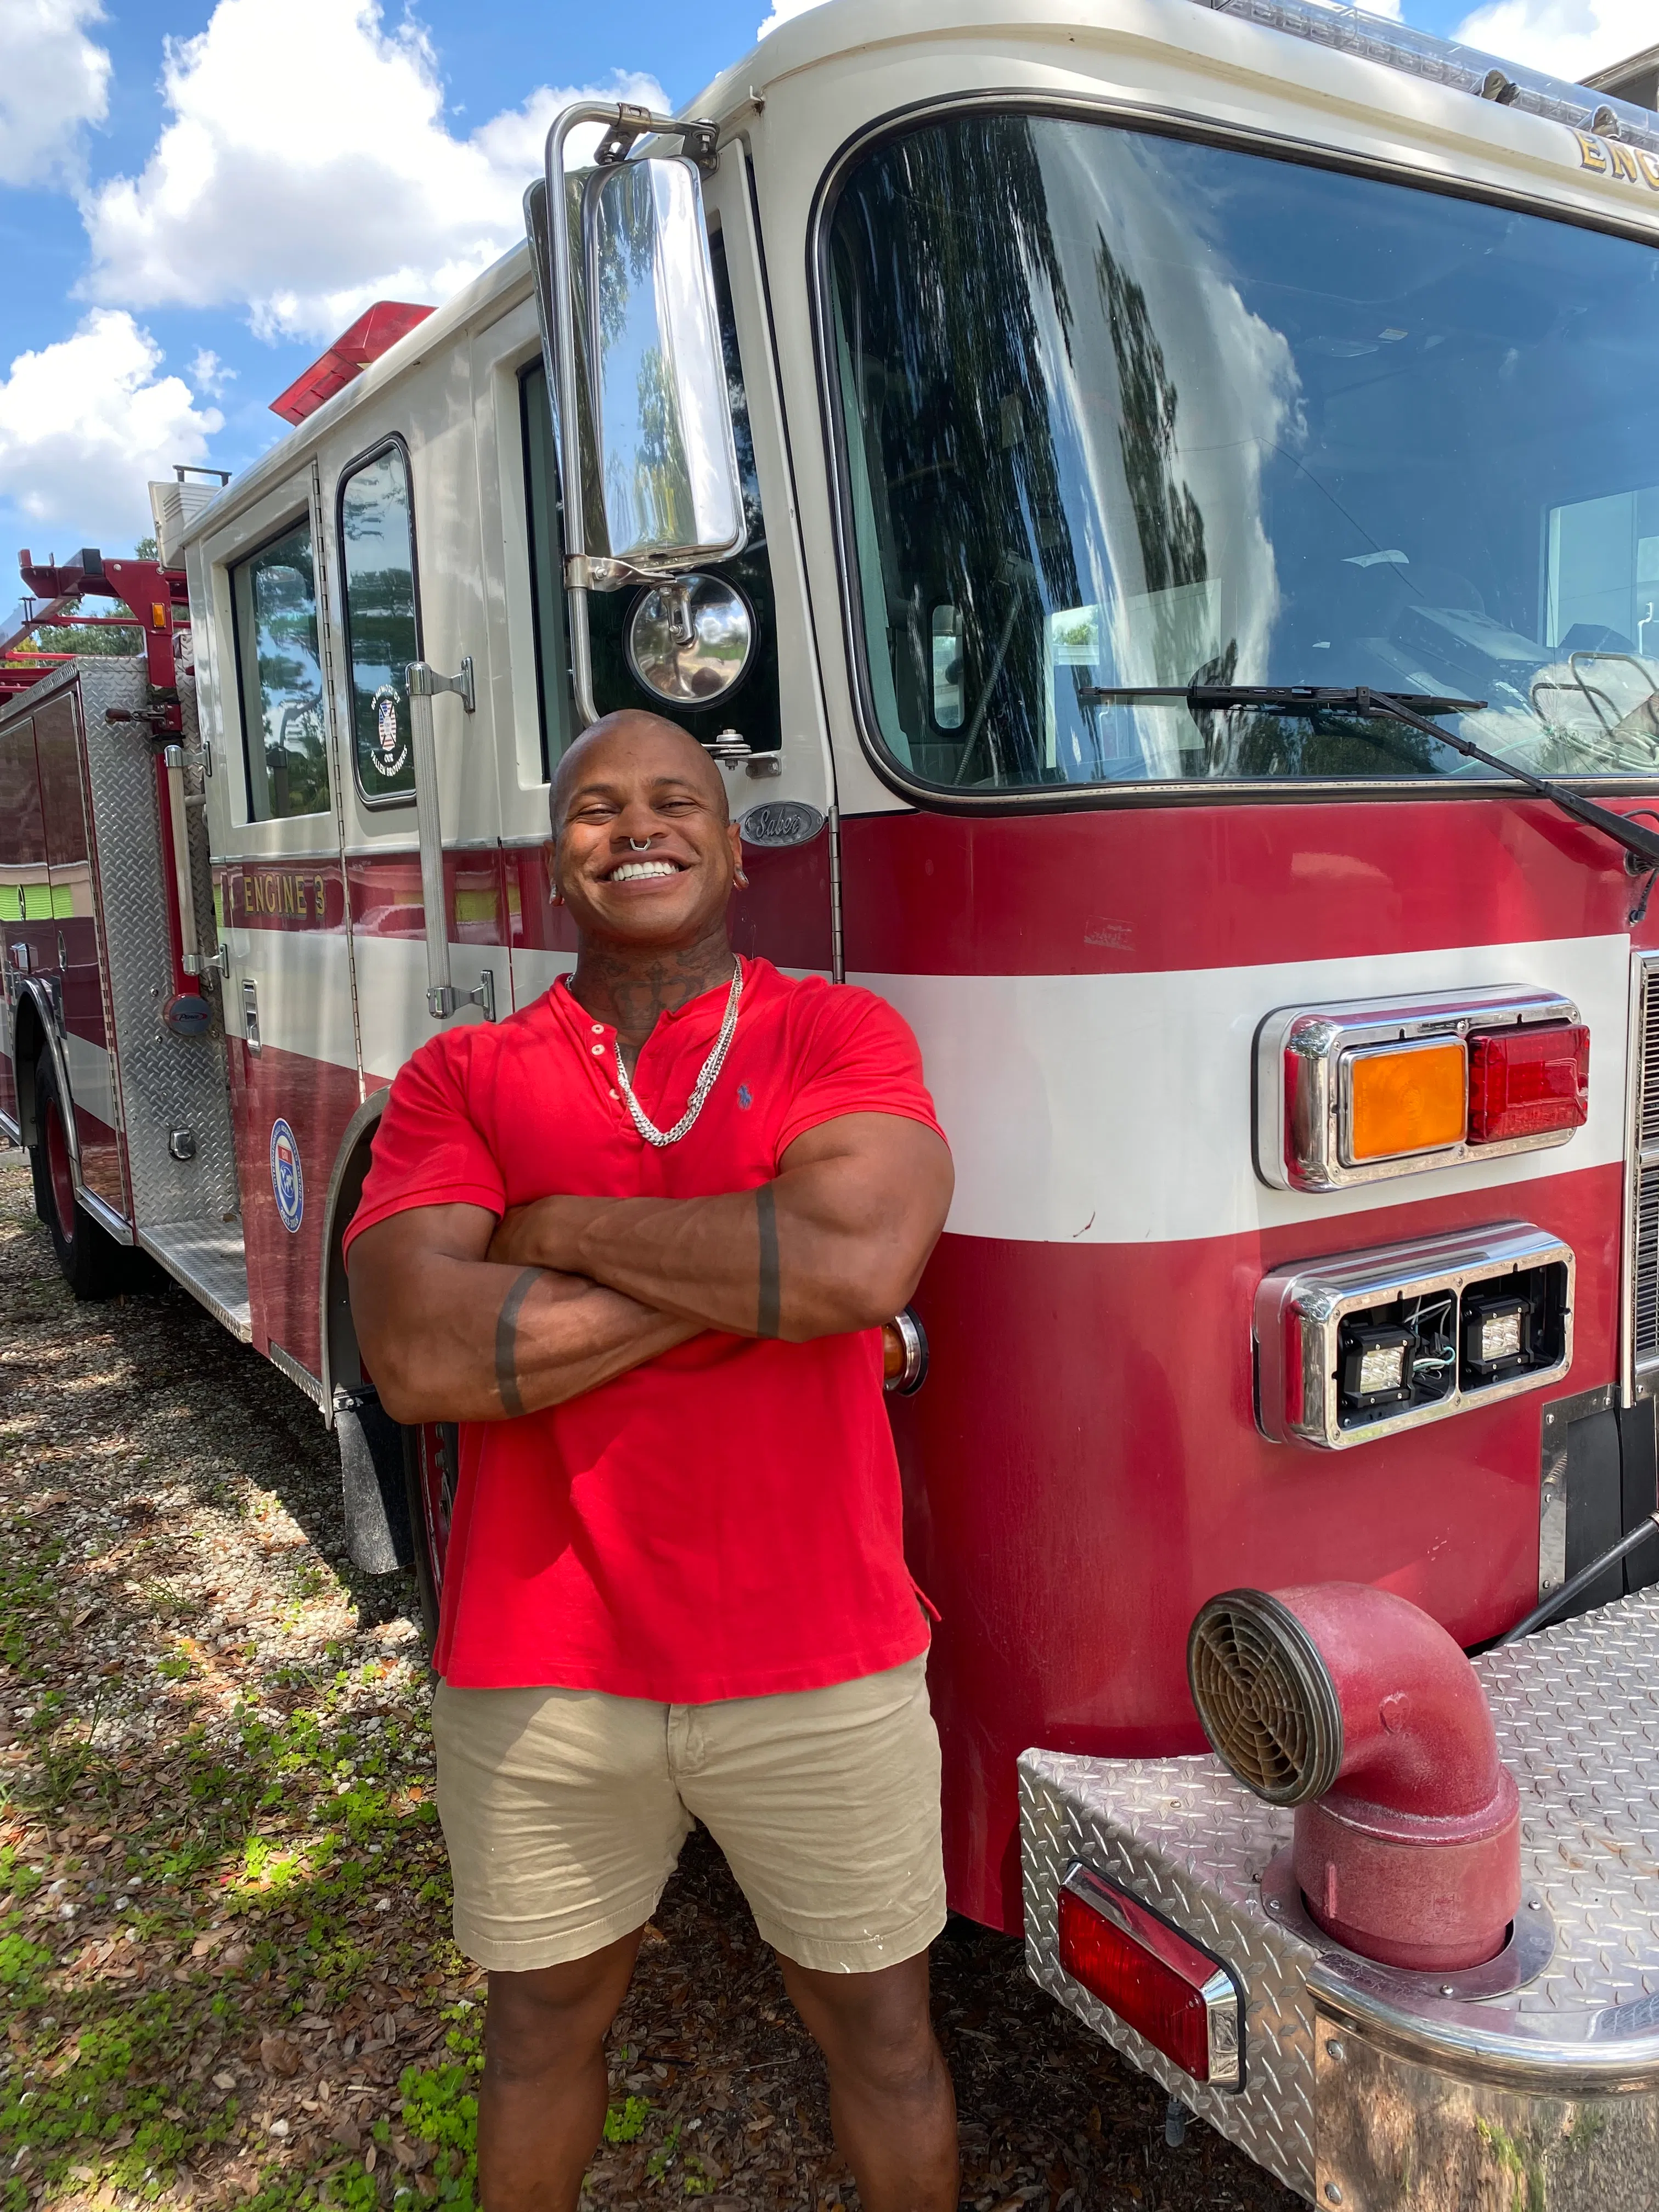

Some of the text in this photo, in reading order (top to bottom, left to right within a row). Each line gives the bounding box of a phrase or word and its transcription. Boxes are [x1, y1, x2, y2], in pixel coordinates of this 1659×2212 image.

[371, 696, 376, 710] IN
[394, 691, 400, 703] OF
[370, 744, 407, 776] FALLEN BROTHERS
[384, 753, 393, 763] OUR
[755, 807, 801, 838] Saber
[242, 873, 326, 919] ENGINE 3
